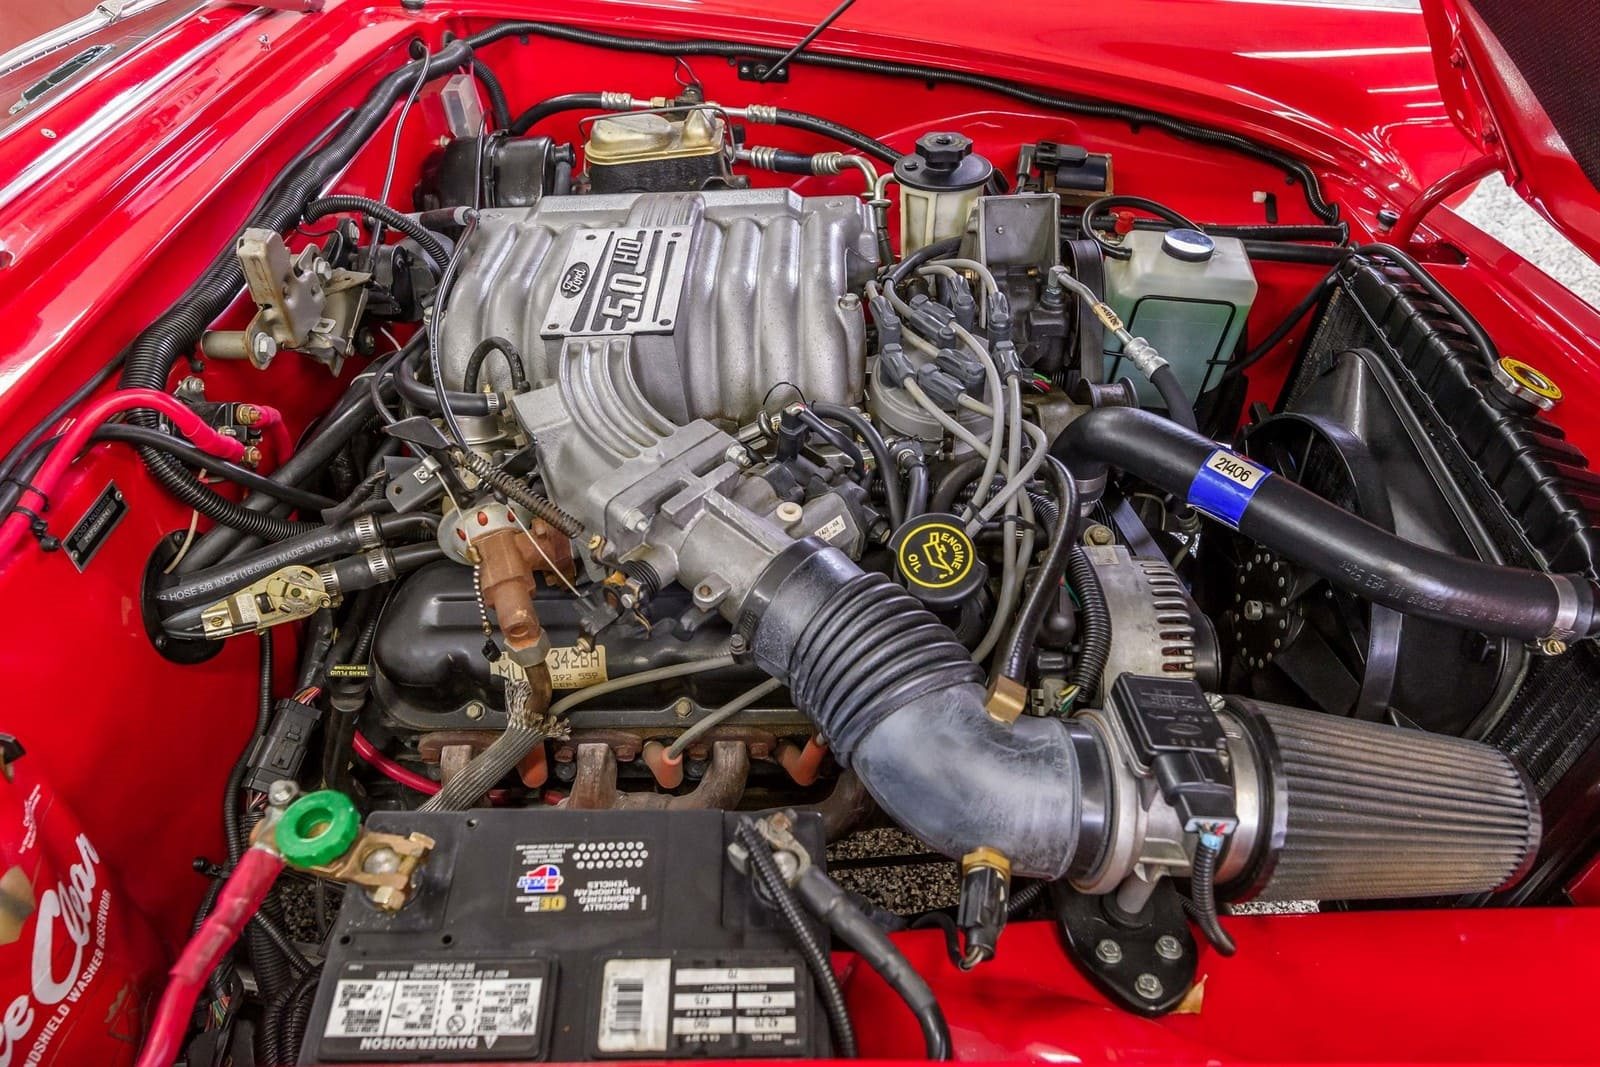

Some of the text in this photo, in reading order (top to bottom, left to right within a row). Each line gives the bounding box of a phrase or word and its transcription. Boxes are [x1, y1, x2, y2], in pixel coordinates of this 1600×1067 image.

[562, 268, 587, 294] Ford
[1214, 457, 1253, 482] 21406
[940, 532, 965, 570] ENGINE
[168, 586, 198, 601] HOSE
[199, 582, 213, 593] 5/8
[213, 572, 239, 590] INCH
[277, 549, 304, 565] MADE
[302, 543, 316, 555] IN
[908, 553, 922, 573] OIL
[574, 887, 641, 897] FOR EUROPEAN
[587, 880, 629, 888] VEHICLES
[579, 895, 635, 904] ENGINEERED
[583, 903, 629, 912] SPECIALLY
[23, 889, 111, 1067] NDSHIELD WASHER RESERVOIR
[702, 984, 736, 993] CAPACITY
